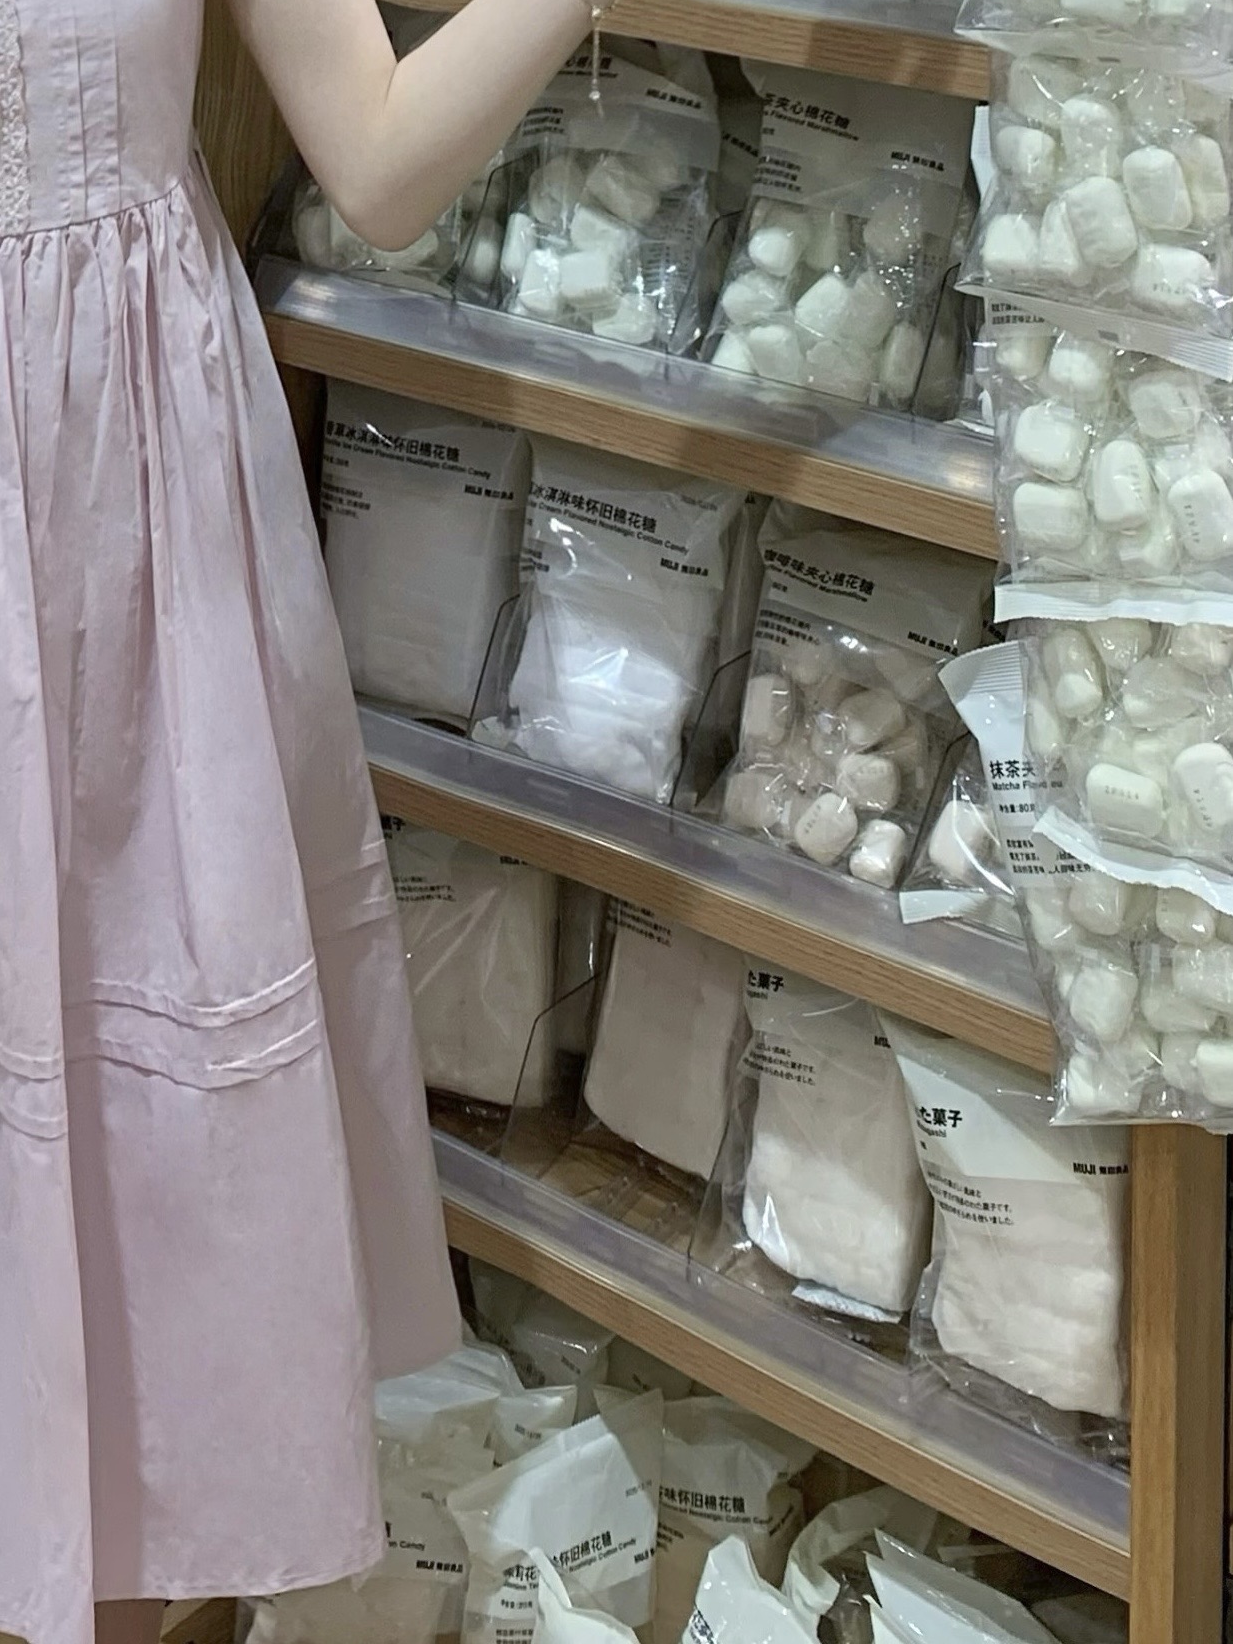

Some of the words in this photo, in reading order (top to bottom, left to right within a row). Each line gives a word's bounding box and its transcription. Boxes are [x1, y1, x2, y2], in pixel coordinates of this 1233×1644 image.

[468, 466, 491, 480] Candy
[538, 502, 562, 516] Cream
[636, 530, 663, 547] Cotton
[664, 539, 690, 556] Candy
[992, 781, 1020, 791] Matcha
[916, 1106, 963, 1128] た菓子
[1073, 1162, 1096, 1175] MUJI
[400, 1540, 426, 1551] Candy
[416, 1559, 435, 1571] MUJI
[436, 1560, 463, 1574] 無印良品
